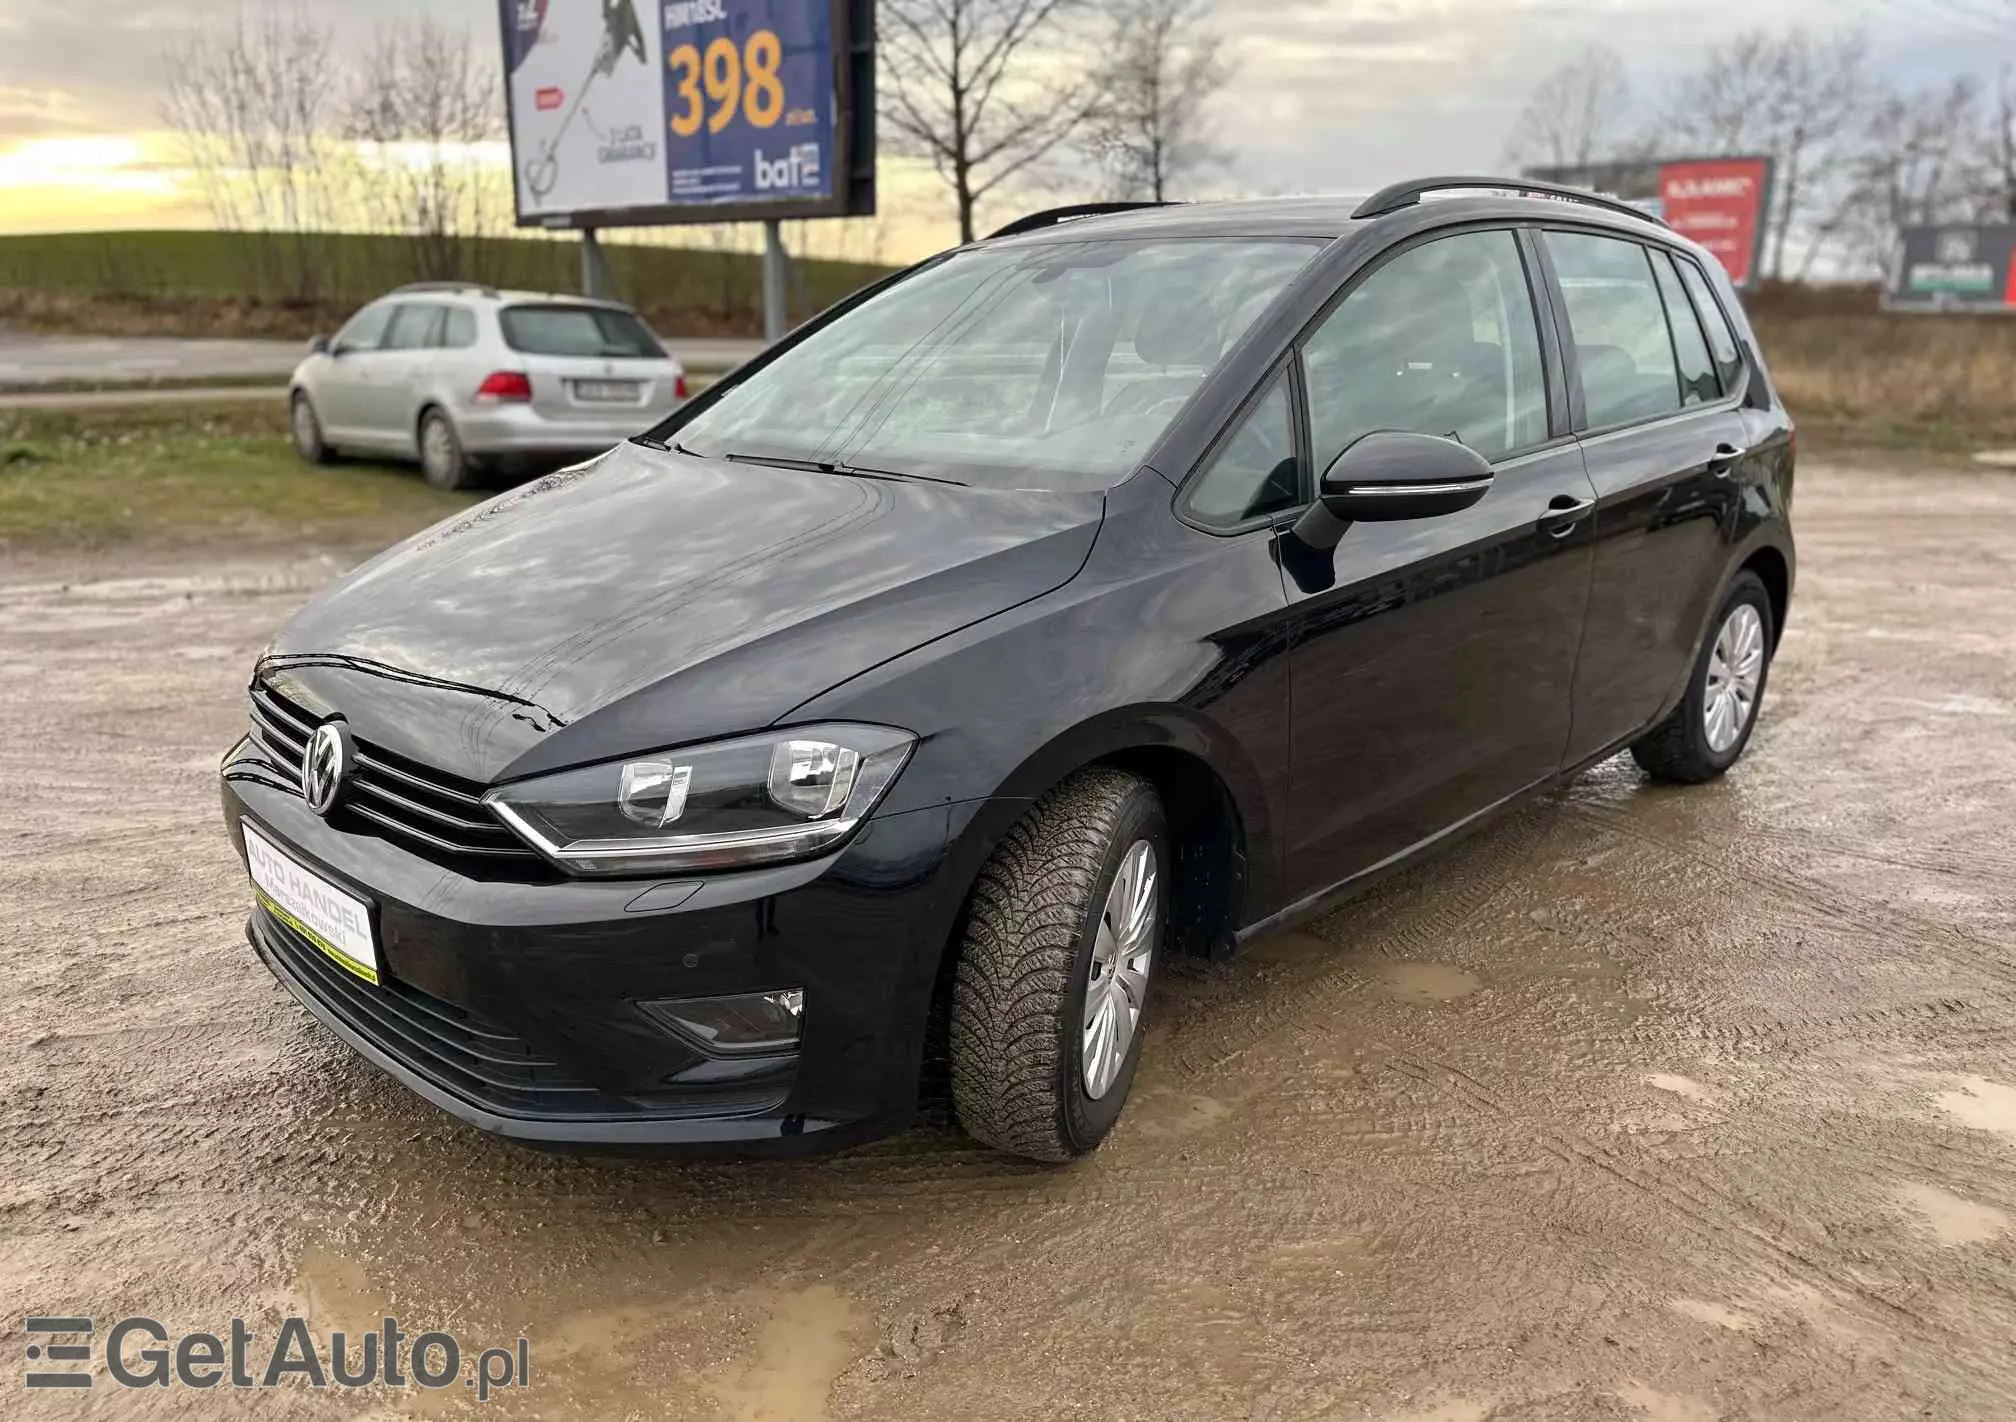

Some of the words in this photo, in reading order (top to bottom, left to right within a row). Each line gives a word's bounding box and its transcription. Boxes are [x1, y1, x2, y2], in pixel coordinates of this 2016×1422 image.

[668, 29, 785, 136] 398
[248, 839, 286, 885] AUTO
[288, 871, 368, 941] HANDEL
